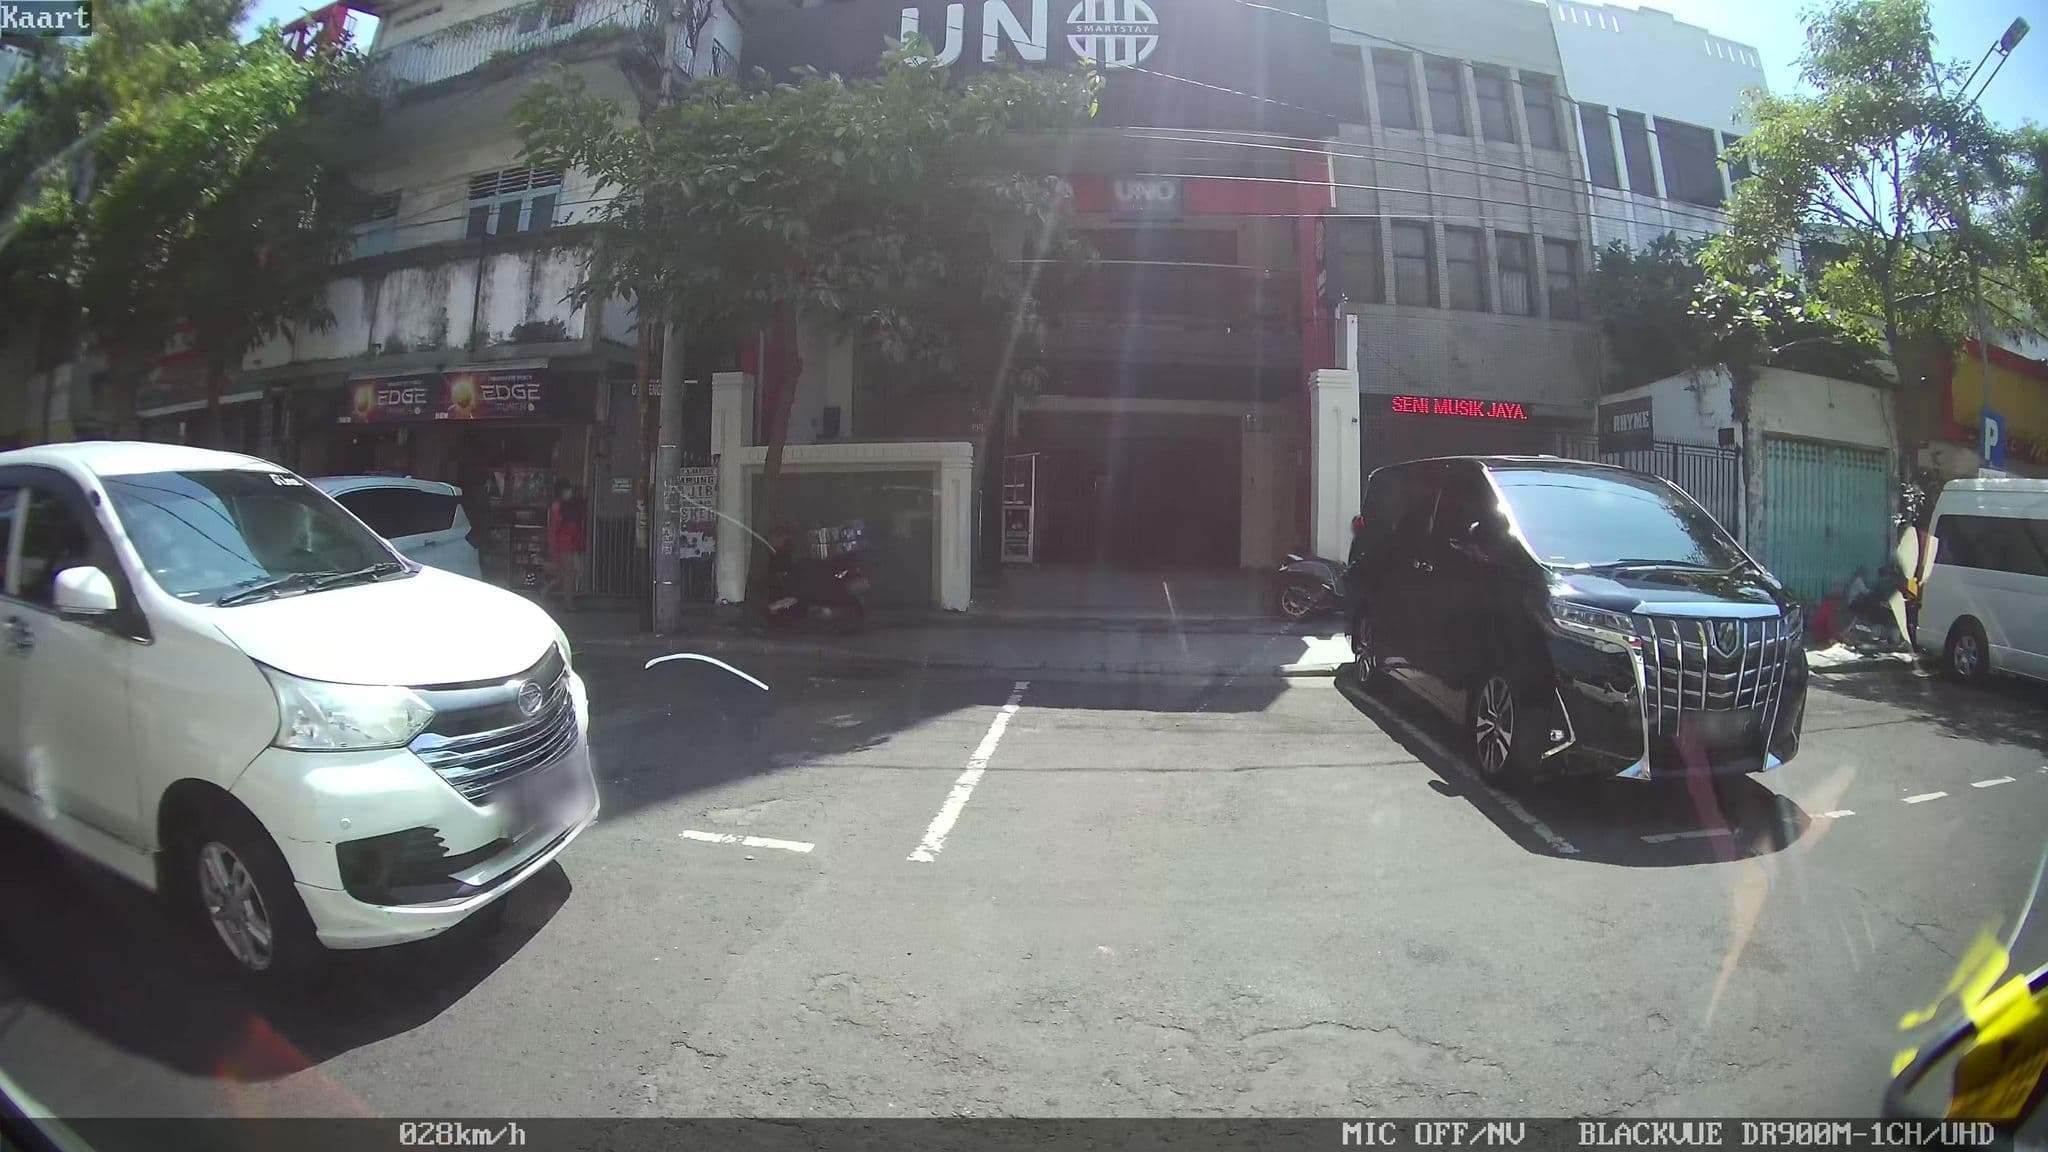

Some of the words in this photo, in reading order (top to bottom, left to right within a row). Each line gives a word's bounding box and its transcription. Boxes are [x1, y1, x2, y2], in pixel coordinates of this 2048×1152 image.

[1075, 24, 1150, 34] SMARTSTAY
[1114, 179, 1176, 201] UNO
[377, 388, 427, 406] EDGE
[480, 384, 541, 401] EDGE
[1393, 397, 1428, 413] SENI
[1433, 400, 1484, 417] MUSIK
[1613, 410, 1650, 433] RHYME
[1984, 416, 1999, 461] P
